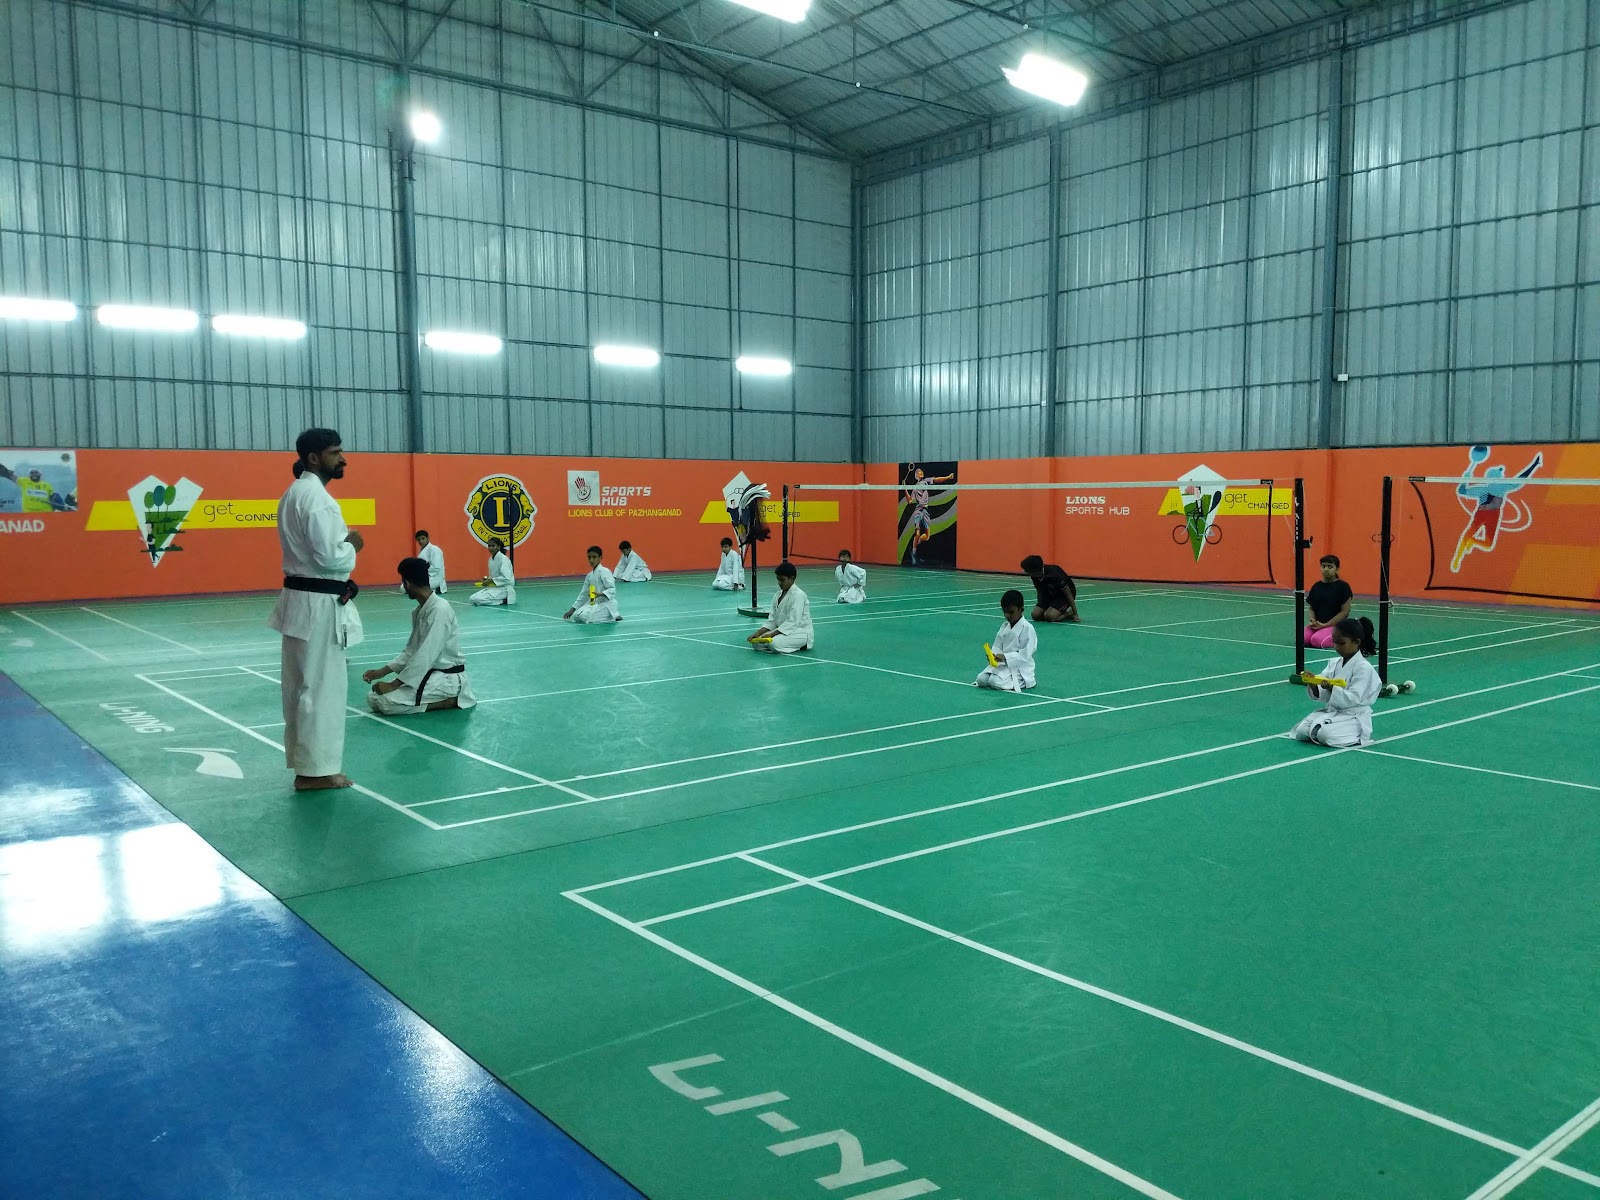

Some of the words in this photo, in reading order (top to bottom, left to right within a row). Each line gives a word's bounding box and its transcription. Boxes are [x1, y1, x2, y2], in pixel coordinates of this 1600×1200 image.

[485, 480, 518, 491] LIONS
[601, 486, 651, 496] SPORTS
[601, 497, 628, 506] HUB
[1065, 496, 1106, 505] LIONS
[1225, 493, 1248, 508] get
[203, 502, 236, 523] get
[235, 513, 278, 522] CONNE
[568, 509, 593, 517] LIONS
[594, 509, 614, 517] CLUB
[628, 508, 682, 516] PAZHANGANAD
[1065, 506, 1104, 515] SPORTS
[1109, 507, 1130, 515] HUB
[99, 702, 176, 734] LI-NING
[648, 1053, 942, 1200] LI-NI
